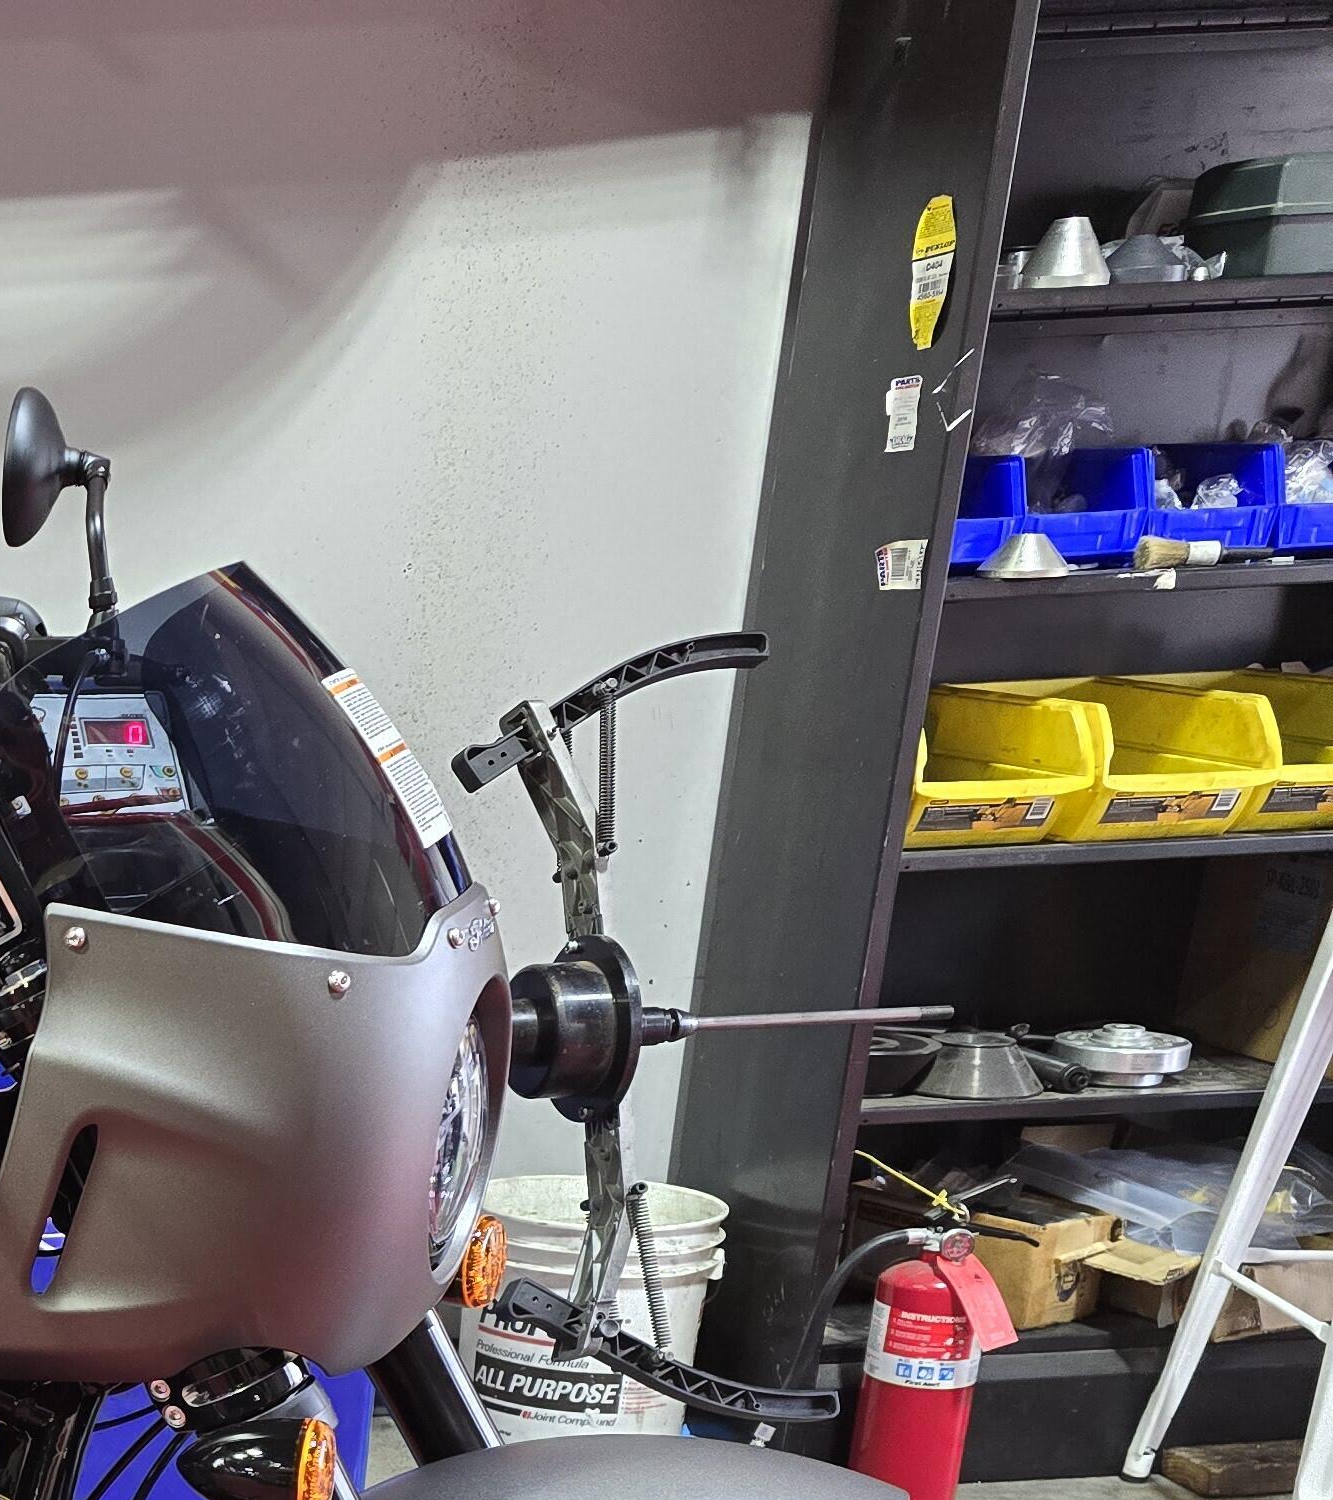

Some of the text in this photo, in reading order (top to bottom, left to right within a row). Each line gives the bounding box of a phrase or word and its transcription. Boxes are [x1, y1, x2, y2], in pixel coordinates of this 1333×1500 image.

[476, 1339, 535, 1362] Professional
[475, 1365, 506, 1391] ALL
[508, 1373, 620, 1405] PURPOSE
[530, 1410, 617, 1428] Joint Compund
